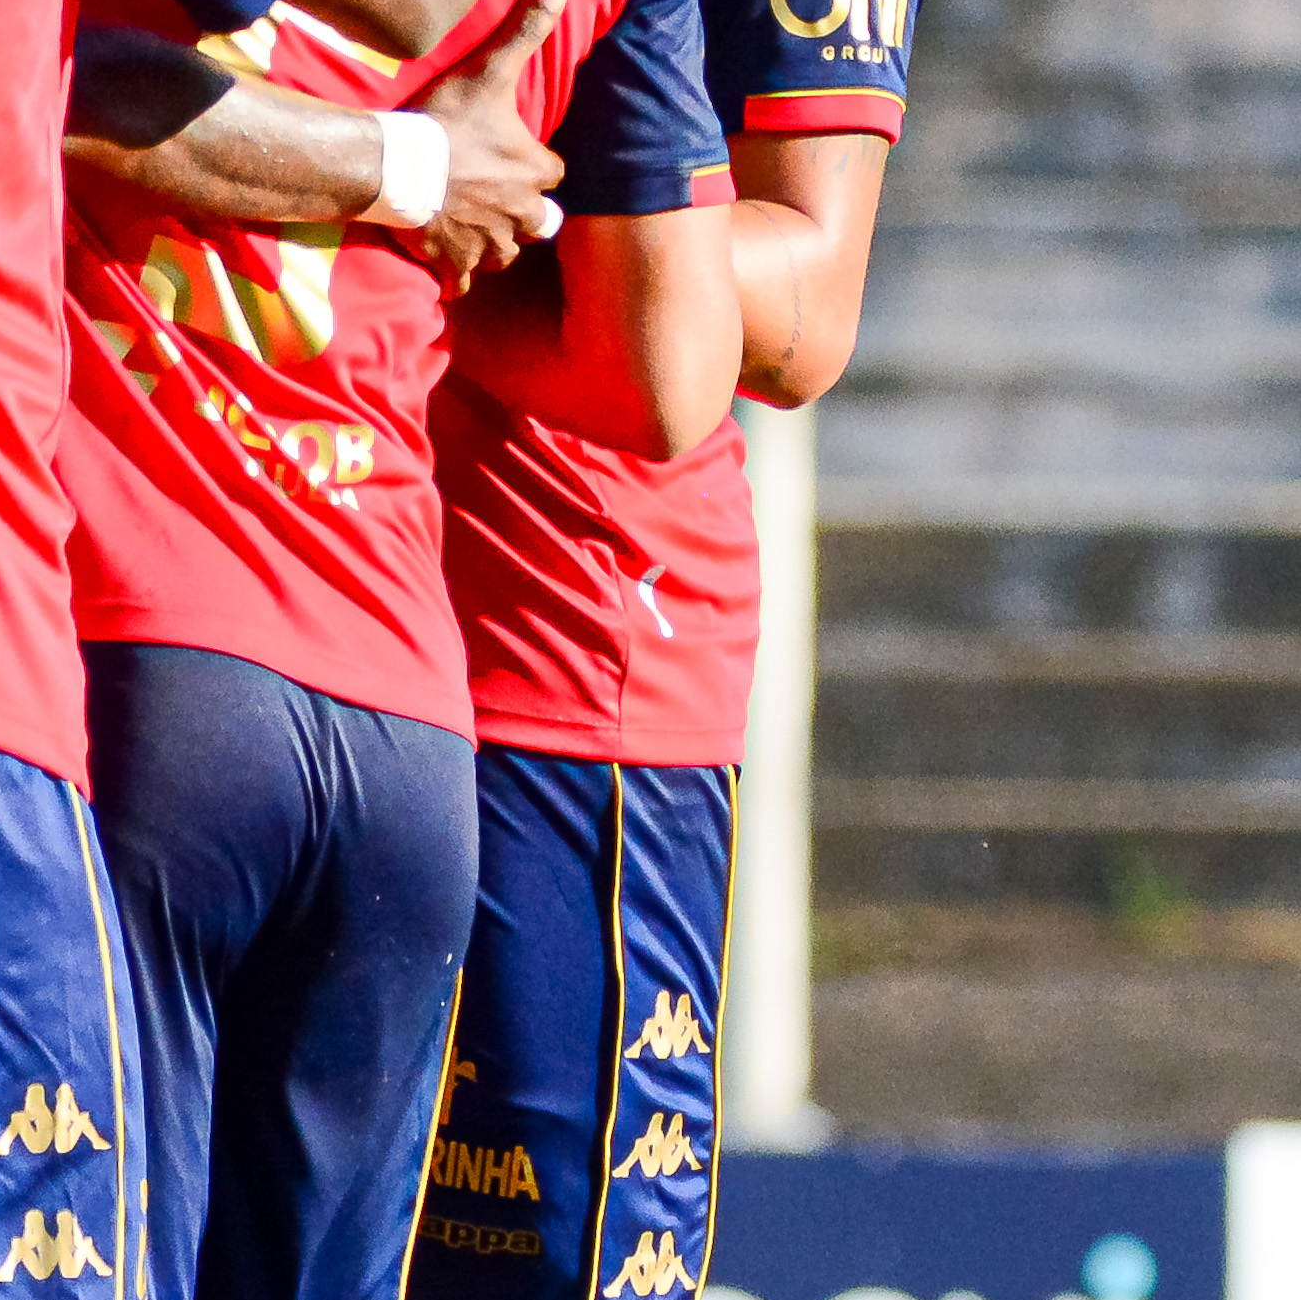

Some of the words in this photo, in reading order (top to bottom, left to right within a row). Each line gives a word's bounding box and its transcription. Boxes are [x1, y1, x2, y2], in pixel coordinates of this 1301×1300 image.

[822, 44, 887, 64] GROU
[433, 1137, 541, 1201] RINHA
[420, 1214, 541, 1255] appa
